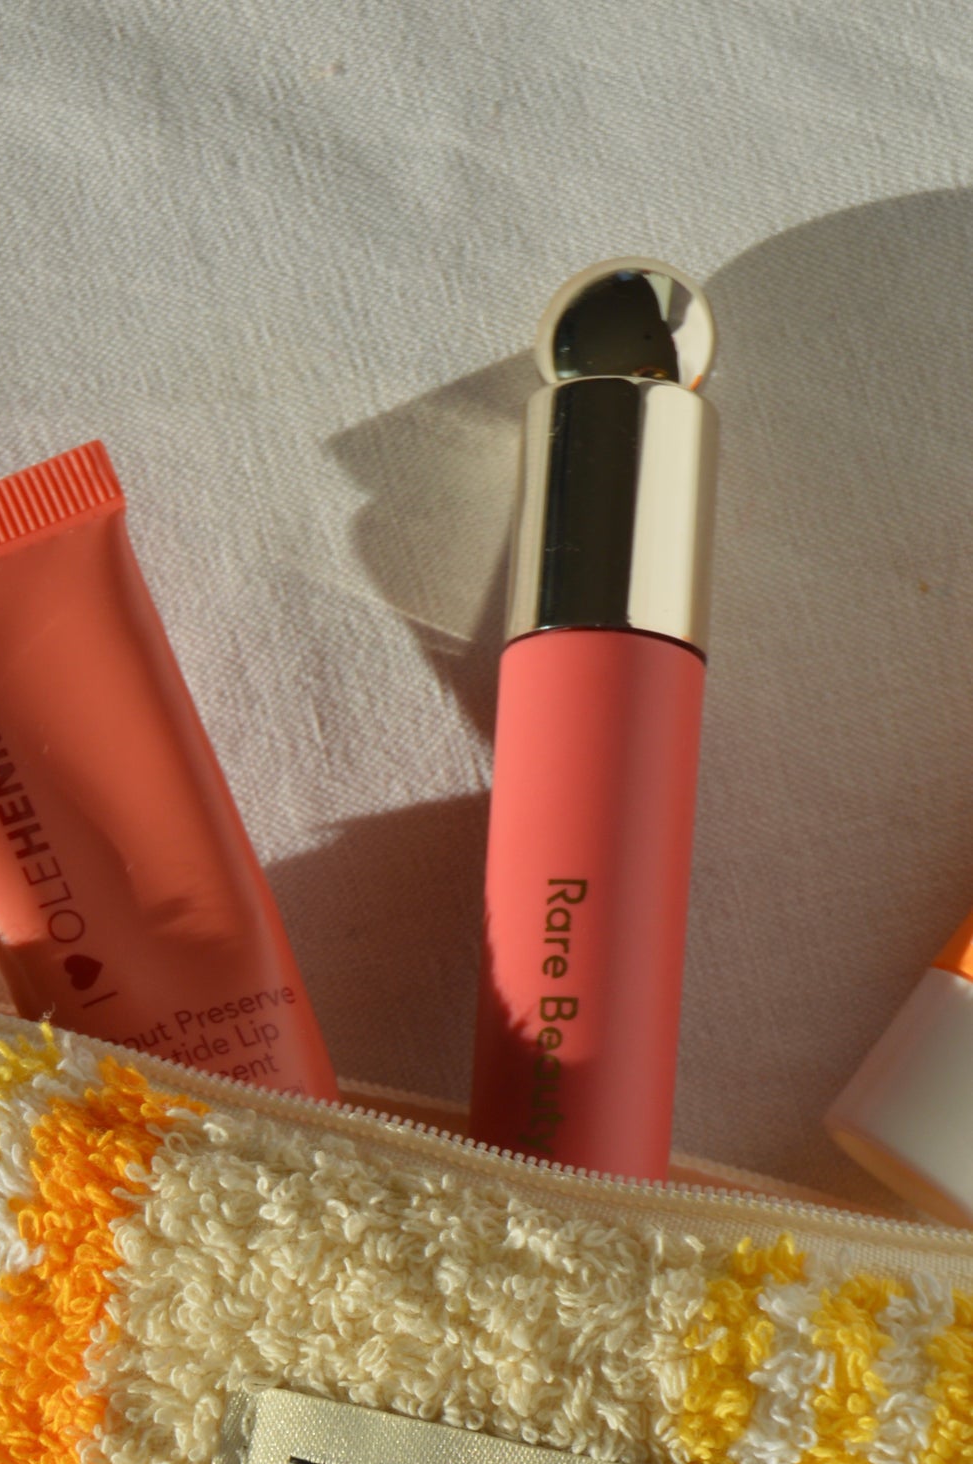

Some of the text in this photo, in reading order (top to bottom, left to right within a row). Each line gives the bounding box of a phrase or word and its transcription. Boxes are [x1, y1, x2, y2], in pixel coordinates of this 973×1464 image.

[105, 986, 297, 1051] out Preserve
[161, 1020, 280, 1067] tide Lip
[518, 878, 588, 1155] Rare Beauty
[209, 1053, 280, 1081] ent
